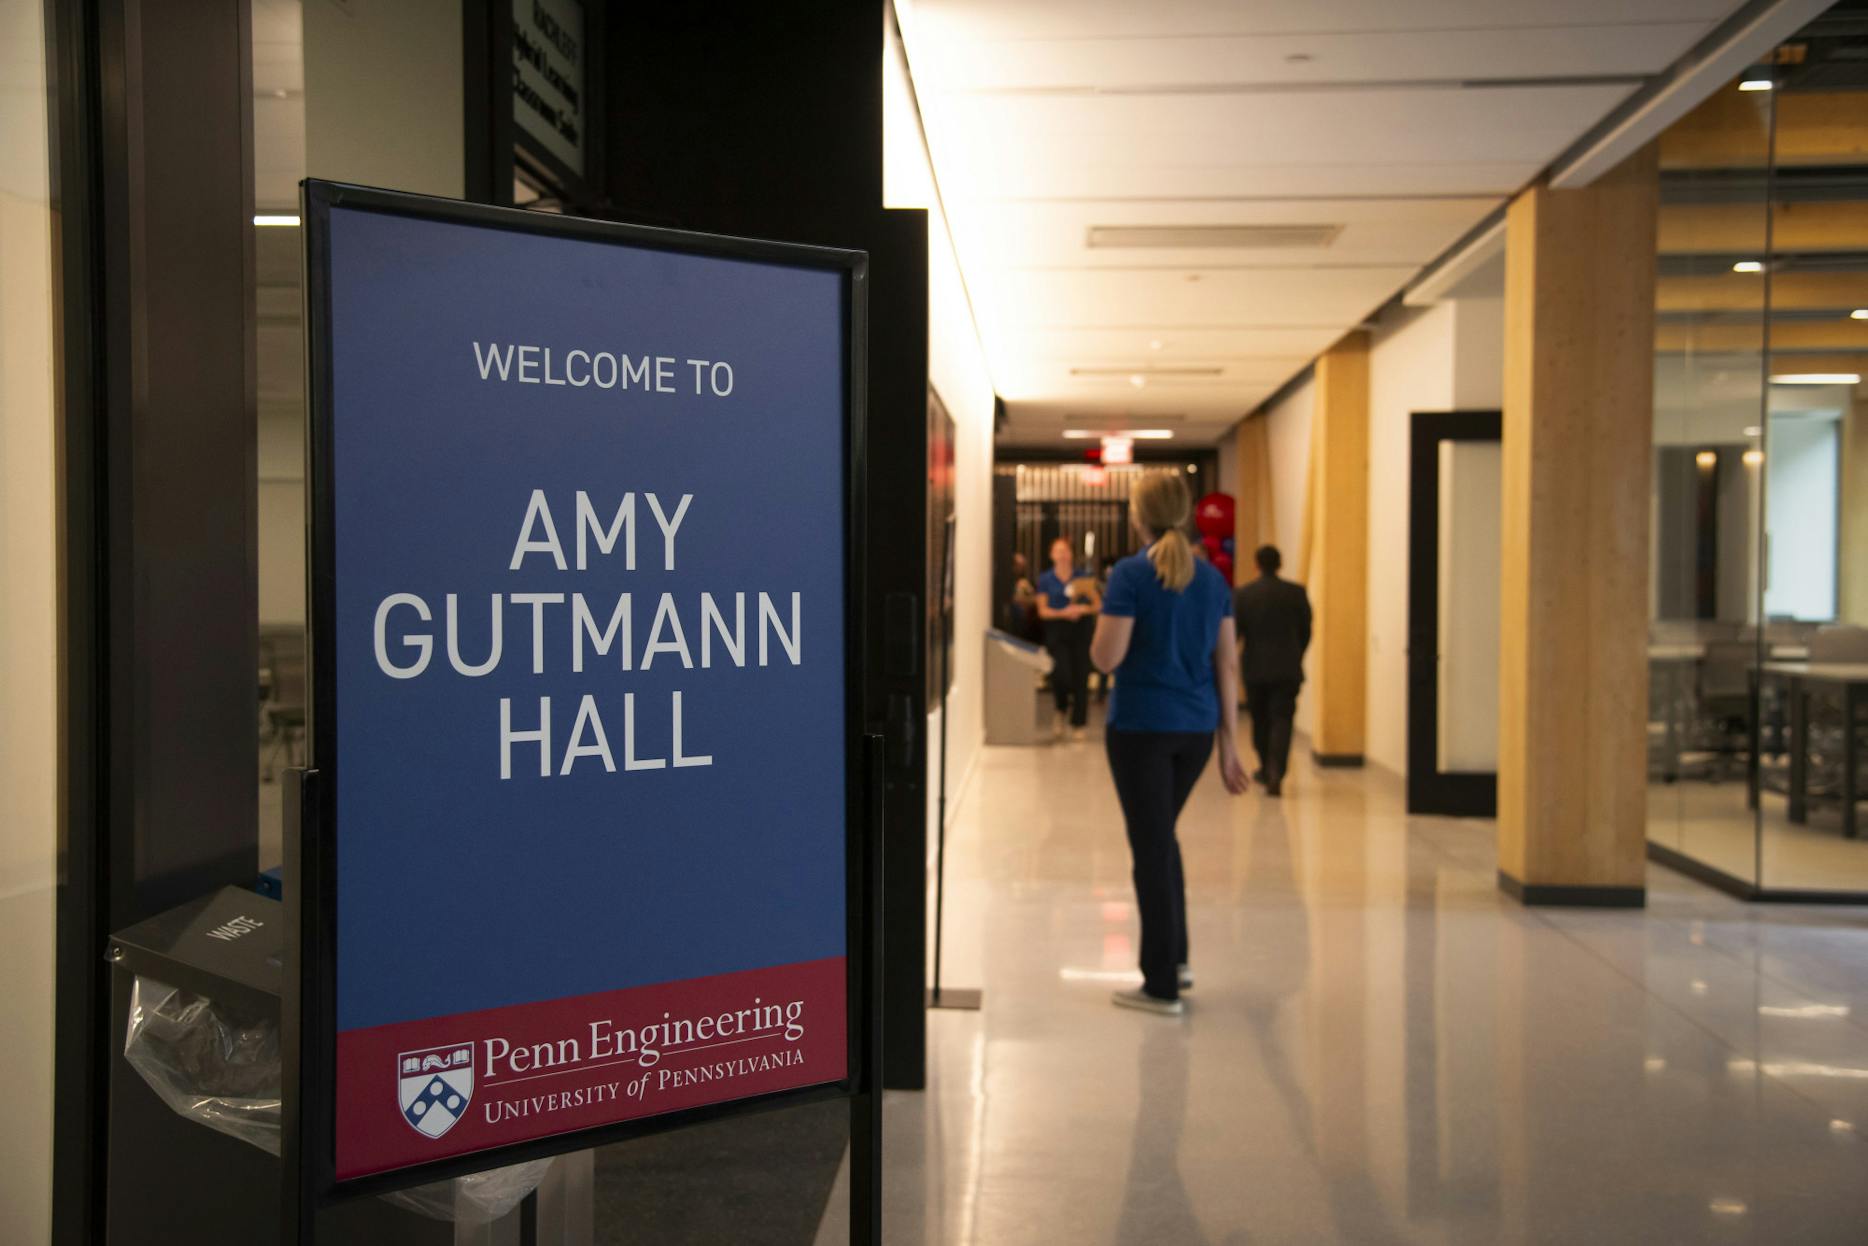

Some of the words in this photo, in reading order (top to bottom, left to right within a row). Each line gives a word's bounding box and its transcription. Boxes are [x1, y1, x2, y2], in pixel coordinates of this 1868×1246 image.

[473, 341, 676, 393] WELCOME
[687, 360, 733, 396] TO
[509, 489, 694, 571] AMY
[374, 592, 800, 678] GUTMANN
[501, 691, 712, 779] HALL
[206, 915, 264, 941] WASTE
[483, 1037, 581, 1077] Penn
[588, 997, 804, 1067] Engineering
[483, 1081, 620, 1125] UNIVERSITY
[626, 1072, 652, 1101] of
[657, 1048, 805, 1091] PENNSYLVANIA
